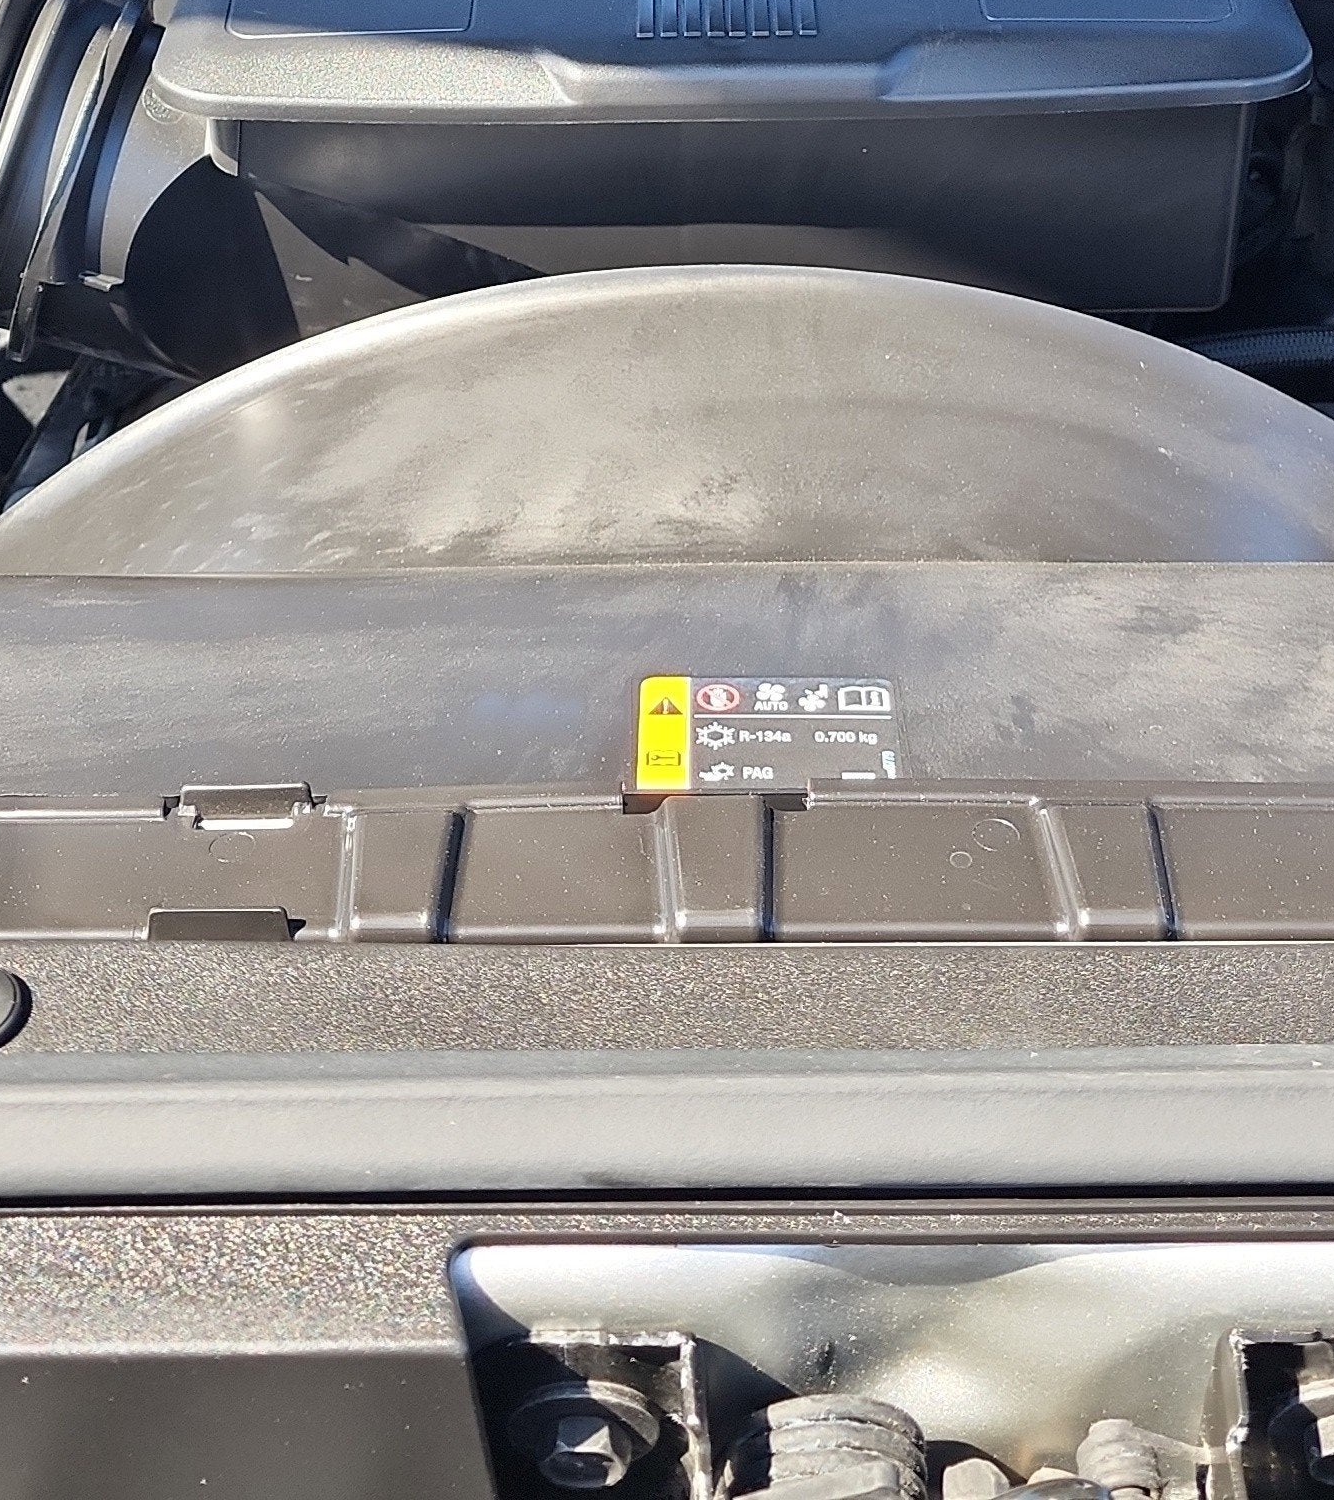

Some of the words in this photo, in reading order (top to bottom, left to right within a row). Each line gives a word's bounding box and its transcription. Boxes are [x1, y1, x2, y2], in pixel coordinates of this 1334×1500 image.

[753, 701, 788, 711] AUTO
[739, 730, 792, 743] R-134a
[814, 731, 855, 743] 0.700
[858, 731, 878, 745] kg
[742, 766, 774, 780] PAG
